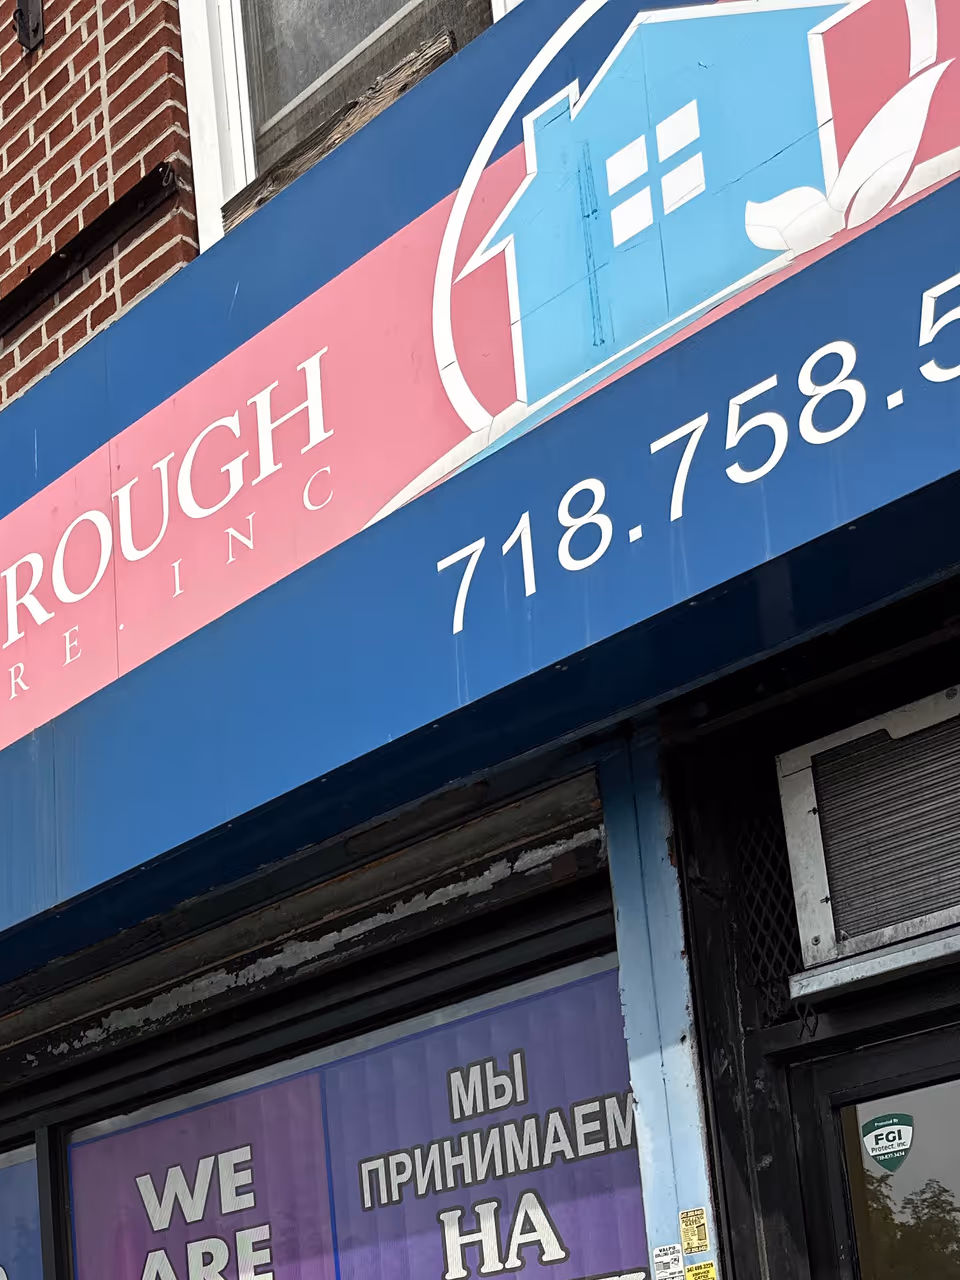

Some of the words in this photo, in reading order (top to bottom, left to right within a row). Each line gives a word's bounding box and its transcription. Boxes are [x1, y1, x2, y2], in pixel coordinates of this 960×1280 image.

[448, 1050, 527, 1121] МЫ
[358, 1091, 638, 1210] ПРИНИМАЕМ
[874, 1128, 903, 1146] FGI
[135, 1144, 256, 1231] WE
